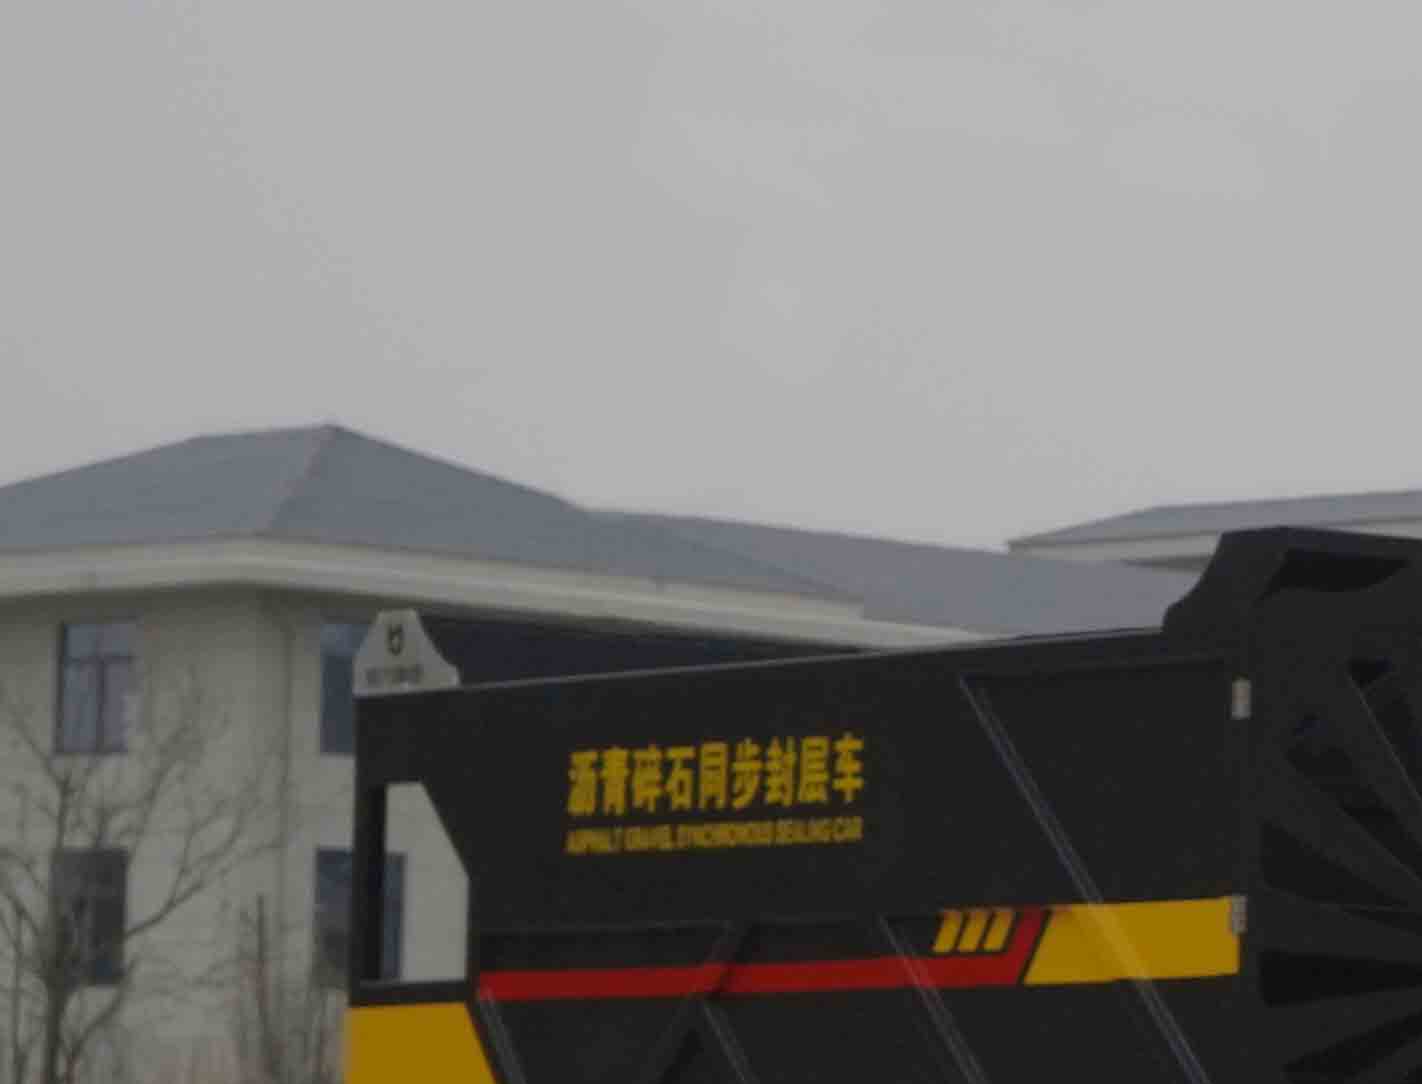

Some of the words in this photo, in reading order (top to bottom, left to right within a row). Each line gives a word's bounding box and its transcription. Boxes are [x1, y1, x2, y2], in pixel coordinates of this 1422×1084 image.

[566, 732, 865, 816] 沥青碎石同步封层车
